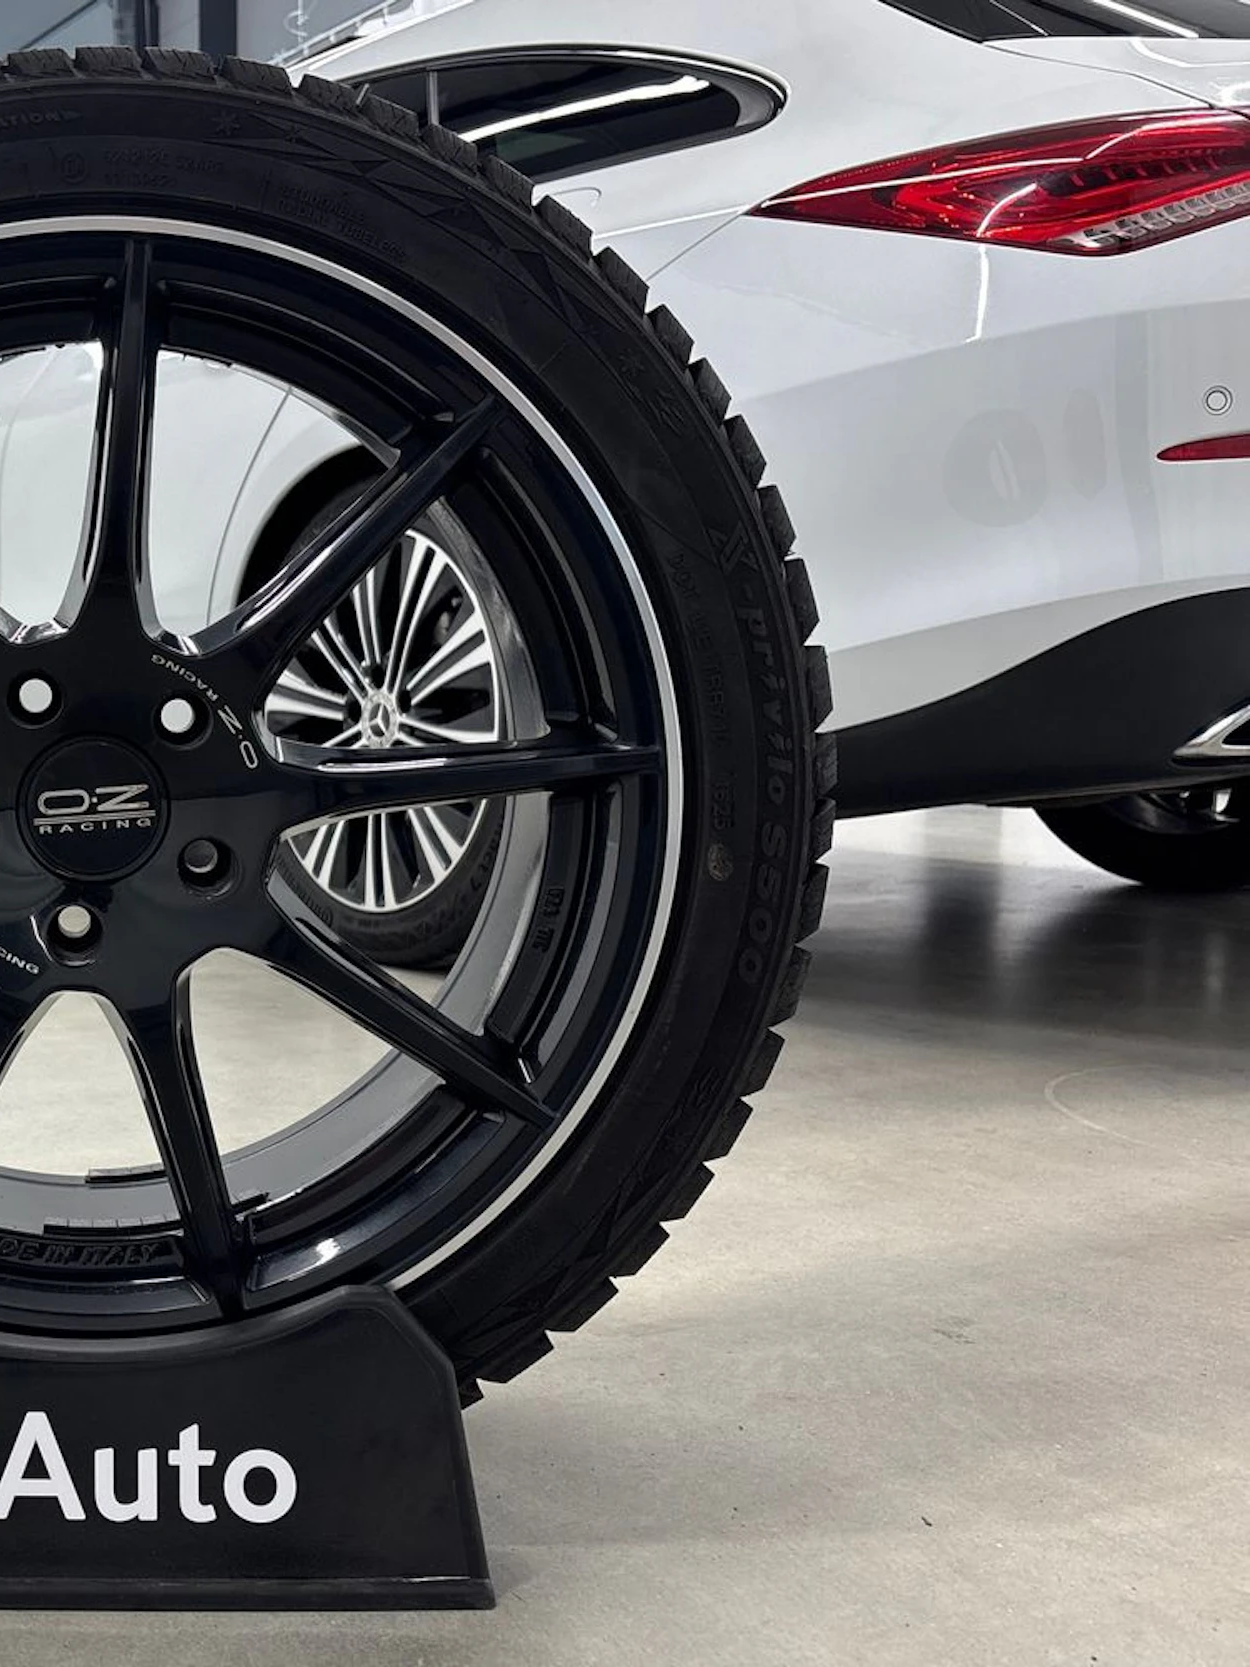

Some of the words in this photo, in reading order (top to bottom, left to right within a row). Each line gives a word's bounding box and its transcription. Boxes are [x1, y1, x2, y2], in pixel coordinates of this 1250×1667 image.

[150, 653, 220, 702] RACING
[38, 817, 152, 835] RACING
[737, 821, 789, 984] S500
